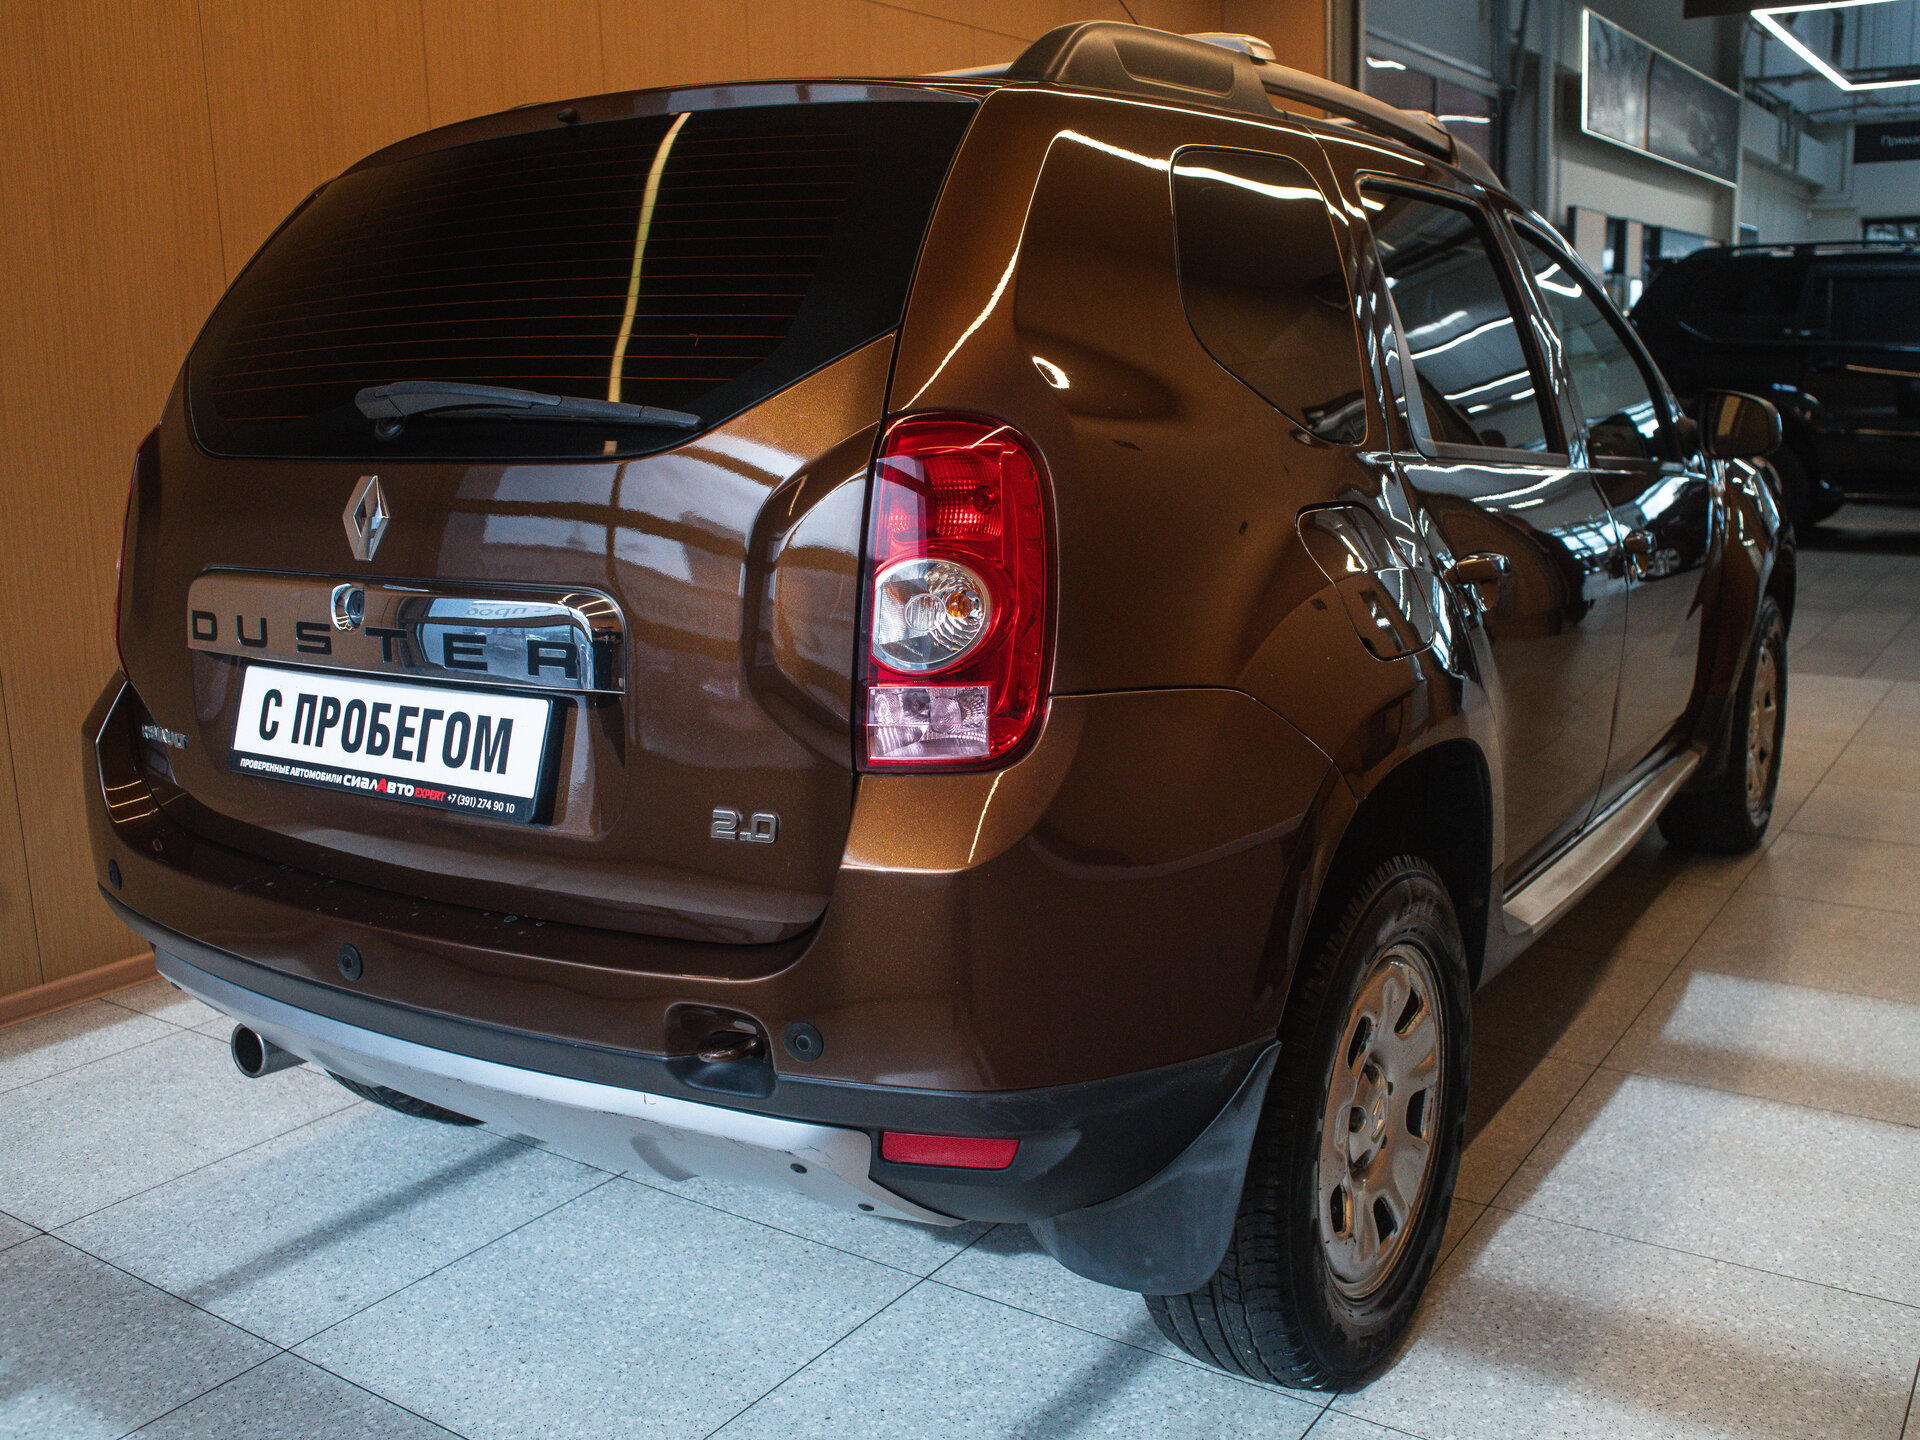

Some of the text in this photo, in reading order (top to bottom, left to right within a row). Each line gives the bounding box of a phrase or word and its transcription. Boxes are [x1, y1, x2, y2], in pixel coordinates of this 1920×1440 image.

[191, 610, 579, 680] DUSTER
[259, 688, 514, 775] С ПРОБЕГОМ
[240, 758, 290, 775] ПРОВЕРЕННЫЕ
[290, 767, 342, 784] АВТОМОБИЛИ
[414, 787, 446, 802] EXPERT
[447, 793, 458, 804] +7
[457, 794, 477, 808] (391)
[477, 798, 492, 810] 274
[493, 801, 504, 812] 90
[505, 803, 516, 814] 10
[711, 808, 780, 844] 2.0
